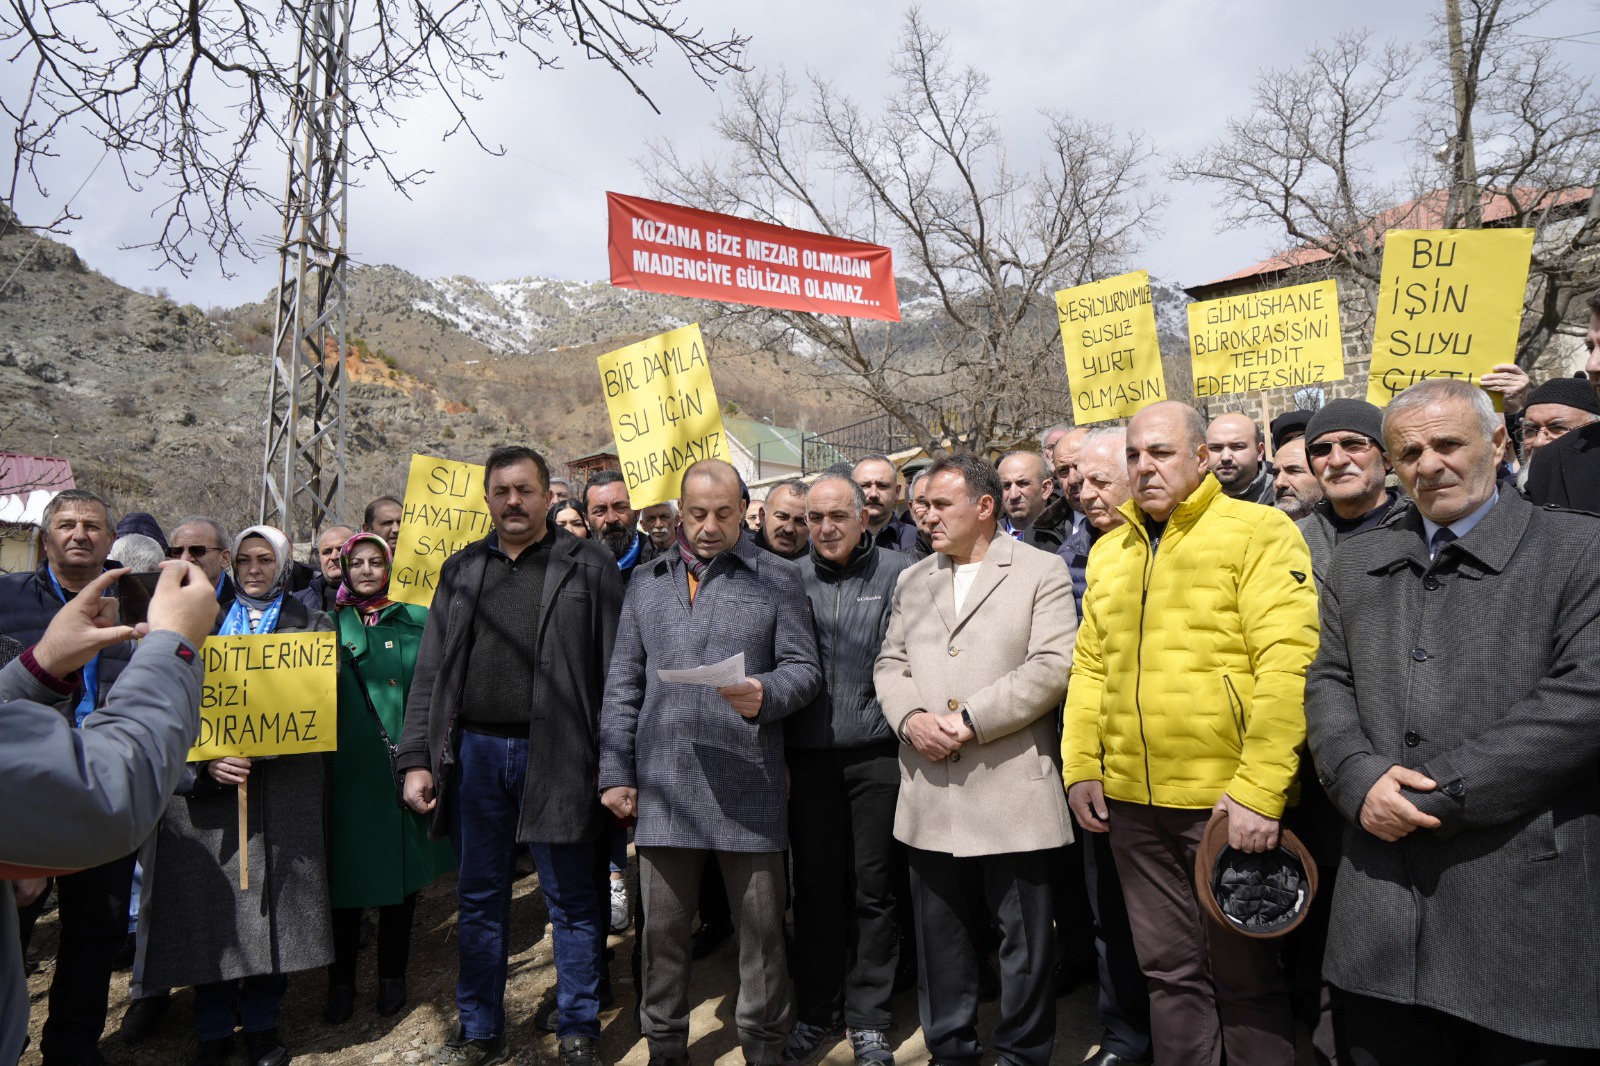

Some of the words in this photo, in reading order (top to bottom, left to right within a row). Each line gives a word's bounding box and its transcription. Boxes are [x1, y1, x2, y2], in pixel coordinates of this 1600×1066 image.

[632, 217, 701, 250] KOZANA
[706, 229, 742, 258] BİZE
[746, 239, 798, 267] MEZAR
[802, 249, 871, 279] OLMADAN
[1412, 238, 1456, 269] BU
[633, 250, 731, 286] MADENCİYE
[736, 265, 800, 296] GÜLİZAR
[804, 278, 880, 307] OLAMAZ...
[1207, 289, 1324, 324] GÜMÜŞHANE
[1392, 275, 1469, 321] İŞİN
[1081, 319, 1133, 348] SUSUZ
[1194, 314, 1328, 356] BÜROKRASİSİNİ
[1389, 329, 1472, 356] SUYU
[604, 362, 639, 398] BİR
[643, 341, 705, 384] DAMLA
[1082, 348, 1135, 378] YURT
[1230, 345, 1303, 368] TEHDİT
[1078, 377, 1160, 411] OLMASIN
[618, 408, 649, 442] SU
[658, 388, 703, 427] İÇİN
[624, 431, 721, 490] BURADAYIZ
[427, 466, 470, 497] SU
[414, 535, 471, 557] SAH
[396, 566, 437, 590] ÇIK
[201, 679, 247, 708] BİZİ
[192, 710, 317, 748] DIRAMAZ
